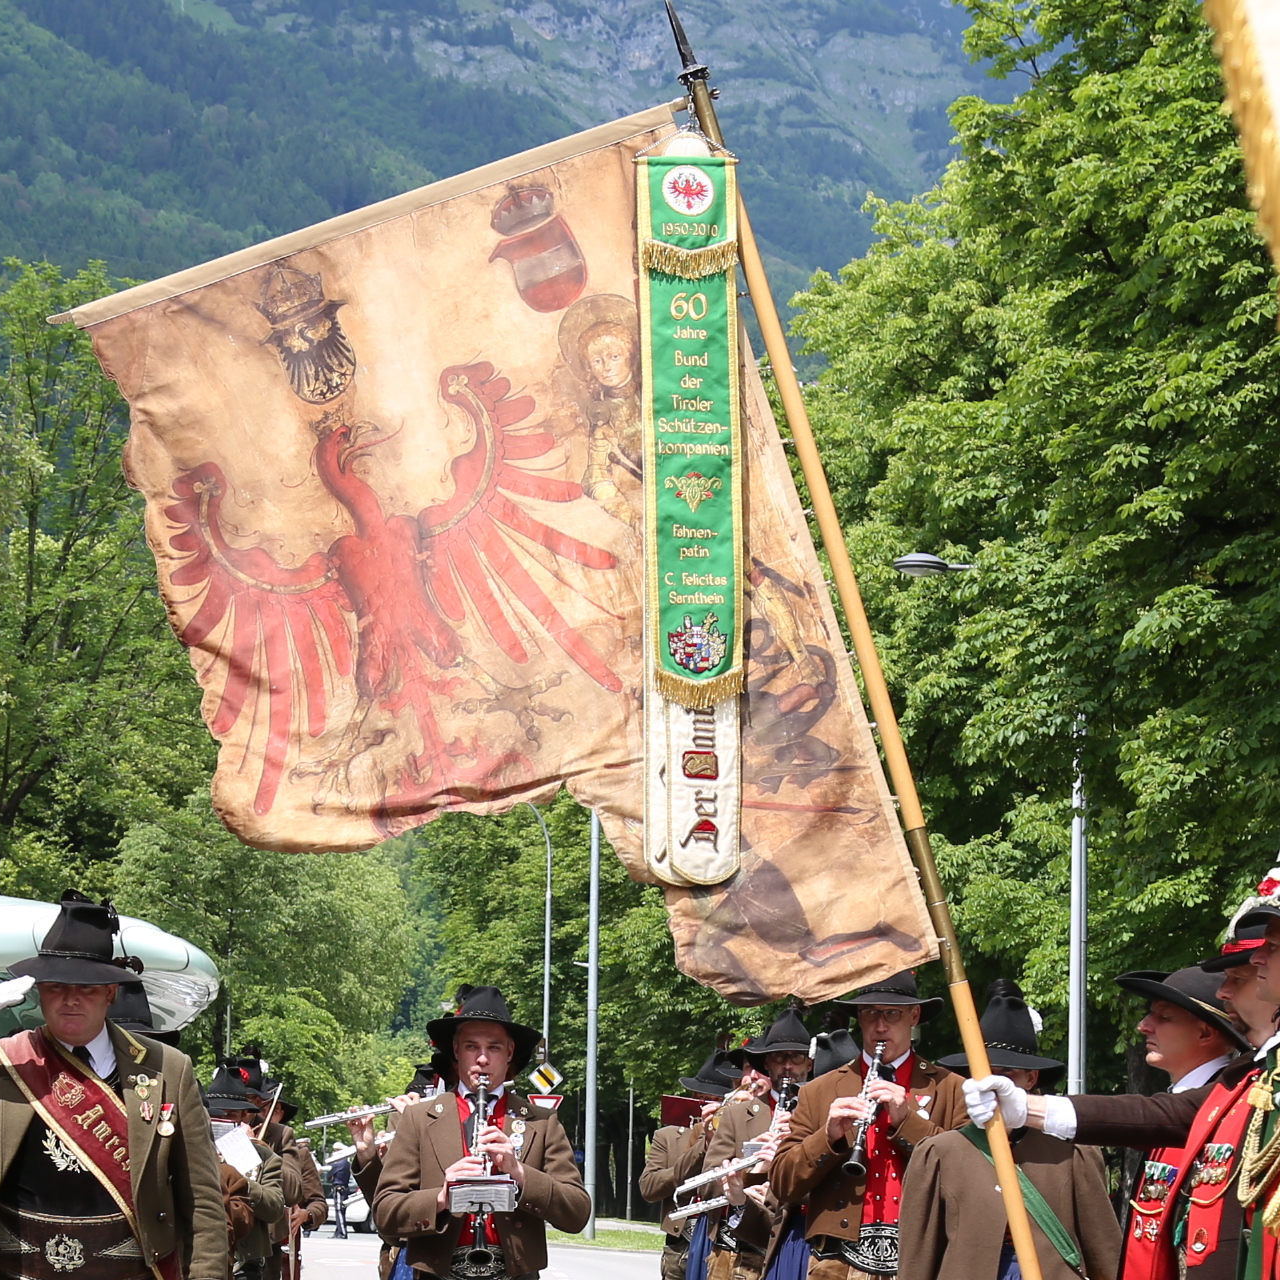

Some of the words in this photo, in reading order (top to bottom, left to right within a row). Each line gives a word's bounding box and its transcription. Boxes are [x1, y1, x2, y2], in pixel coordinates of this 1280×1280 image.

[661, 222, 719, 238] 1950-2010
[670, 293, 708, 321] 60
[673, 325, 708, 342] Jahre
[674, 350, 708, 367] Bund
[680, 374, 703, 390] der
[671, 395, 714, 413] Tiroler
[658, 416, 729, 434] Schützen-
[658, 441, 729, 457] kompanien
[672, 523, 718, 539] Fahnen-
[679, 543, 710, 561] patin
[664, 572, 677, 586] C.
[682, 572, 728, 586] Felicitas
[669, 590, 725, 605] Sarnthein
[678, 789, 720, 853] Der
